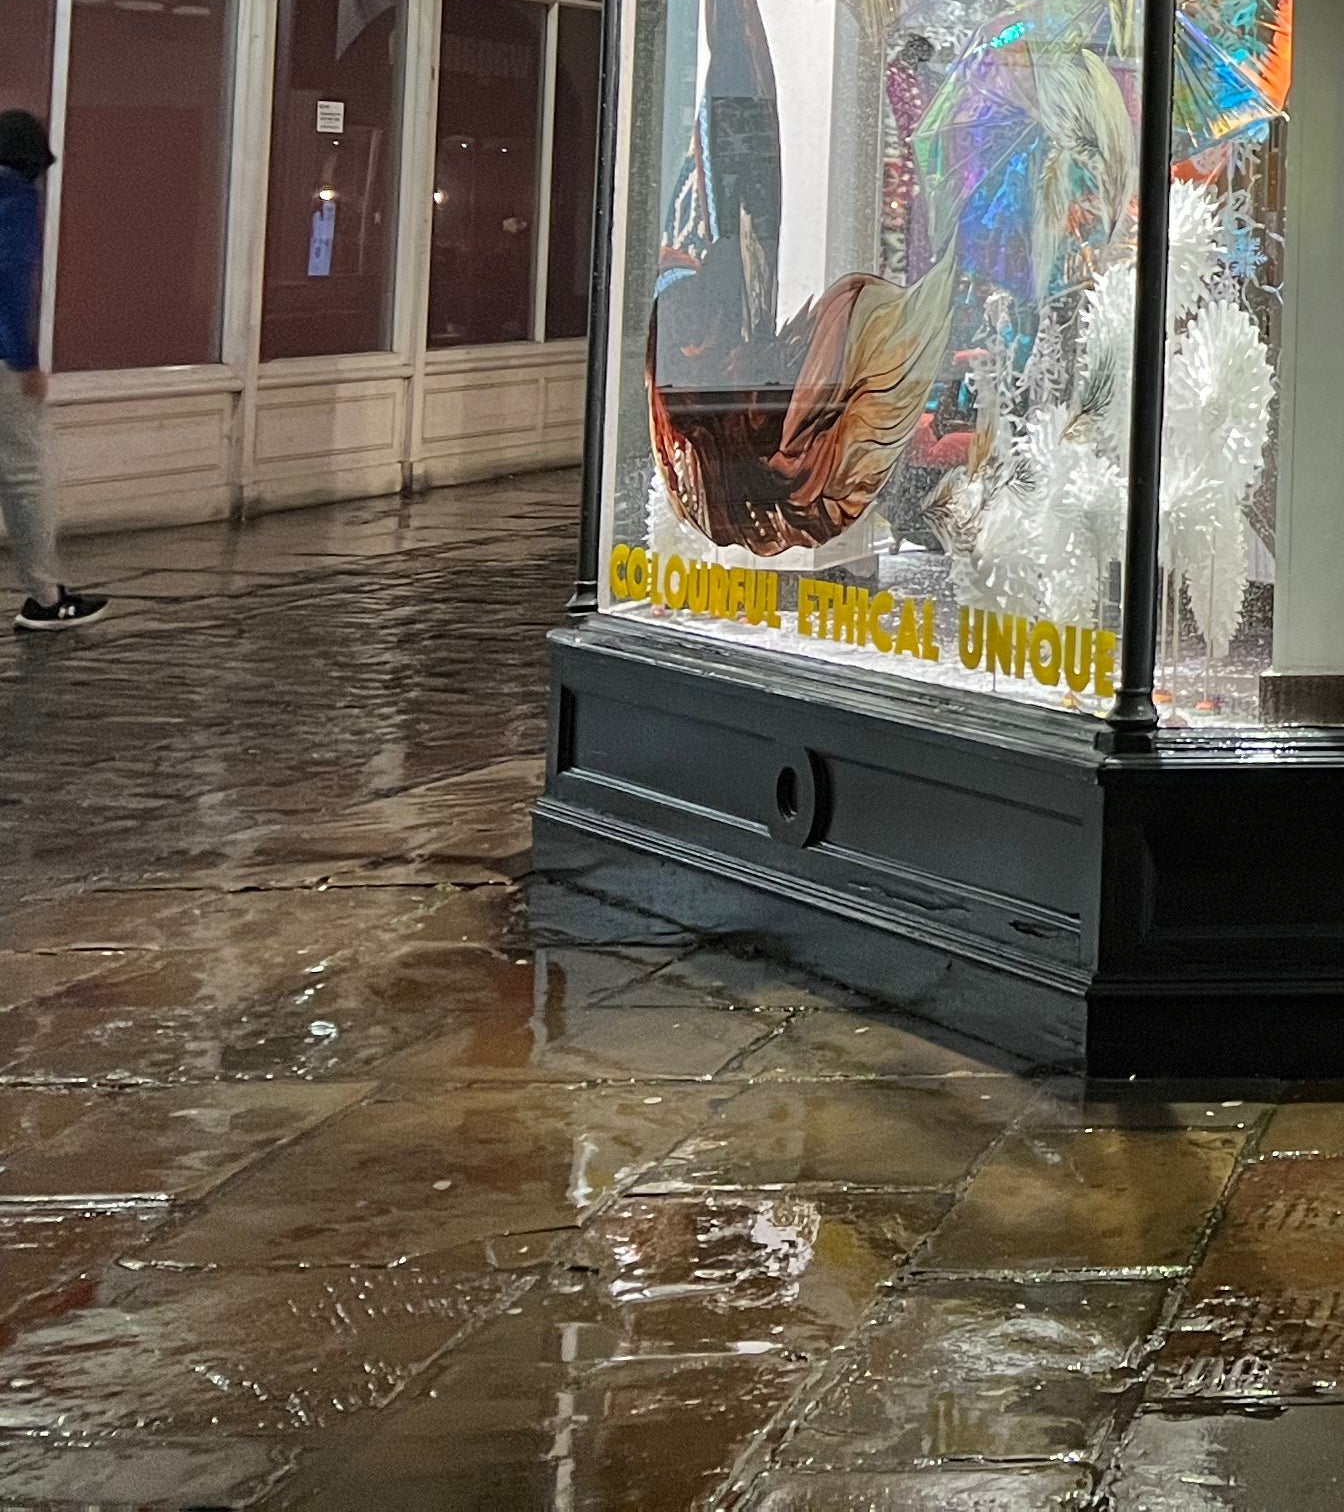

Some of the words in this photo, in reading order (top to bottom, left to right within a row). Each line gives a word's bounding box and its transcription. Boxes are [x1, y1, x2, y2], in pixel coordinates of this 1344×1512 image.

[609, 544, 781, 629] COLOURFUL
[797, 578, 940, 661] ETHICAL
[958, 605, 1117, 697] UNIQUE
